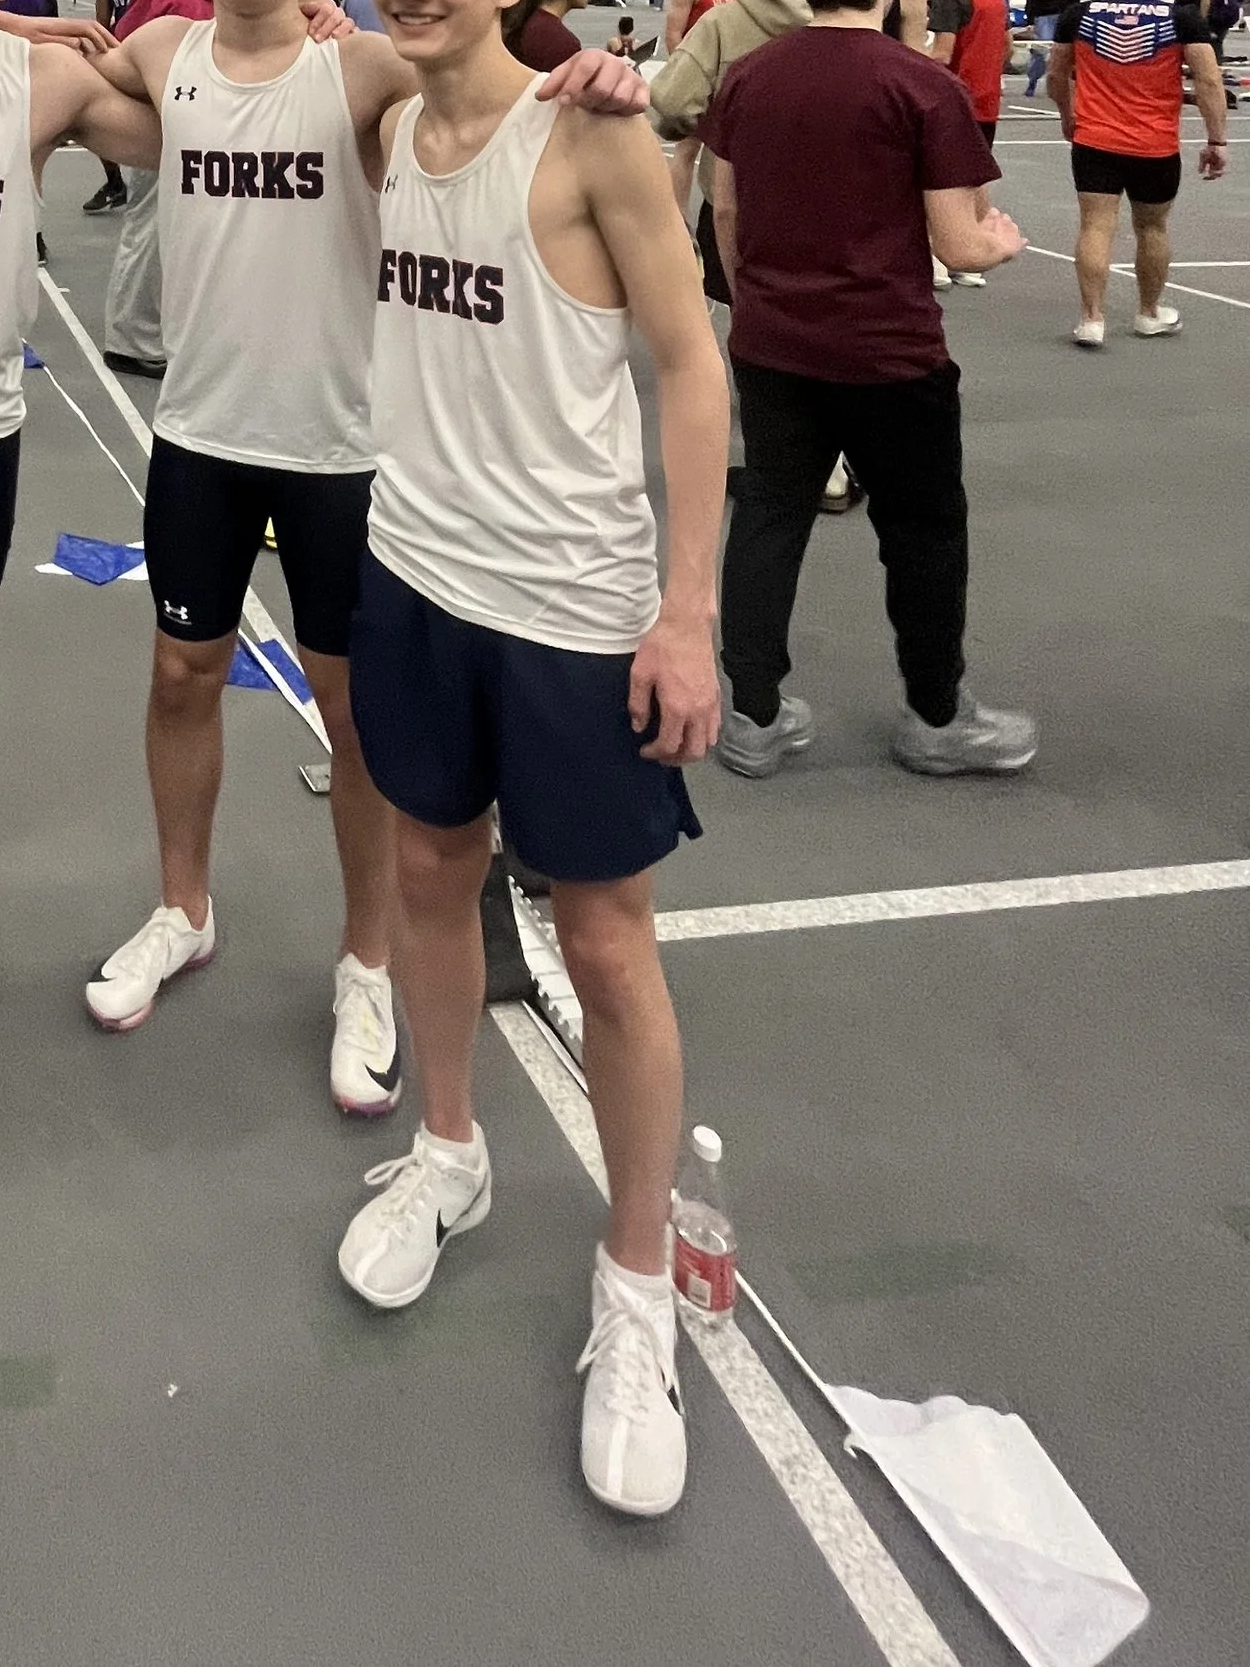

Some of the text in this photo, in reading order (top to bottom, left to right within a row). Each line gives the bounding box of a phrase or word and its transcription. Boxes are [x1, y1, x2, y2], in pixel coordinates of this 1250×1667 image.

[1089, 1, 1170, 17] SPARTANS
[181, 149, 324, 199] FORKS
[377, 248, 505, 325] FORKS
